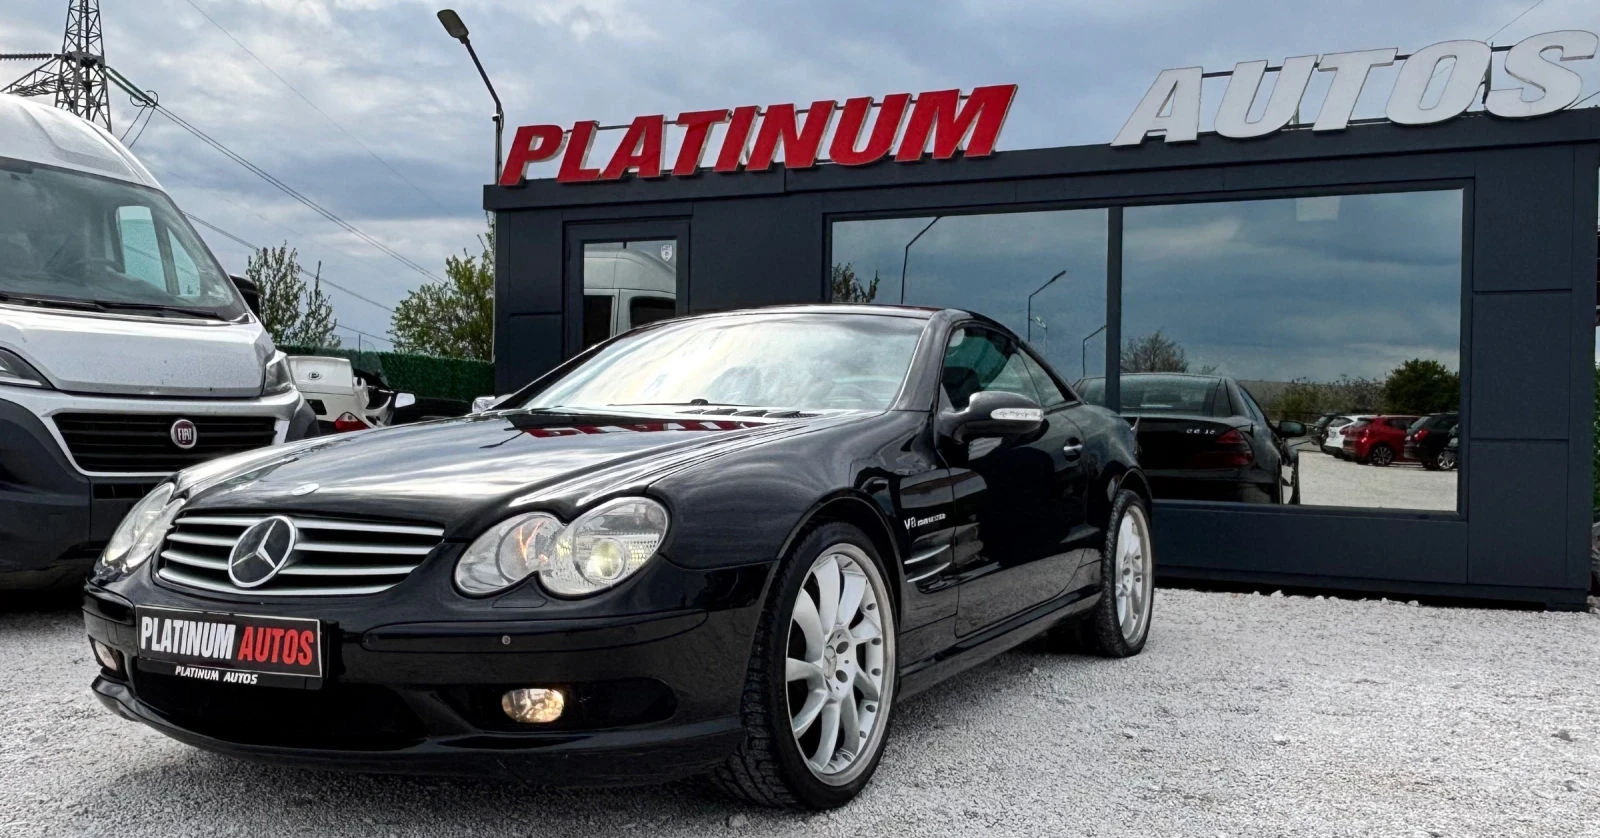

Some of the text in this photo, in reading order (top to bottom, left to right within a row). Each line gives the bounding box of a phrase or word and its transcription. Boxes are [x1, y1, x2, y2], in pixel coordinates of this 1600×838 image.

[499, 29, 1599, 186] PLATINUM AUTOS
[177, 427, 192, 441] FIAT
[140, 616, 315, 666] PLATINUM AUTOS
[175, 665, 258, 685] PLATINUM AUTOS
